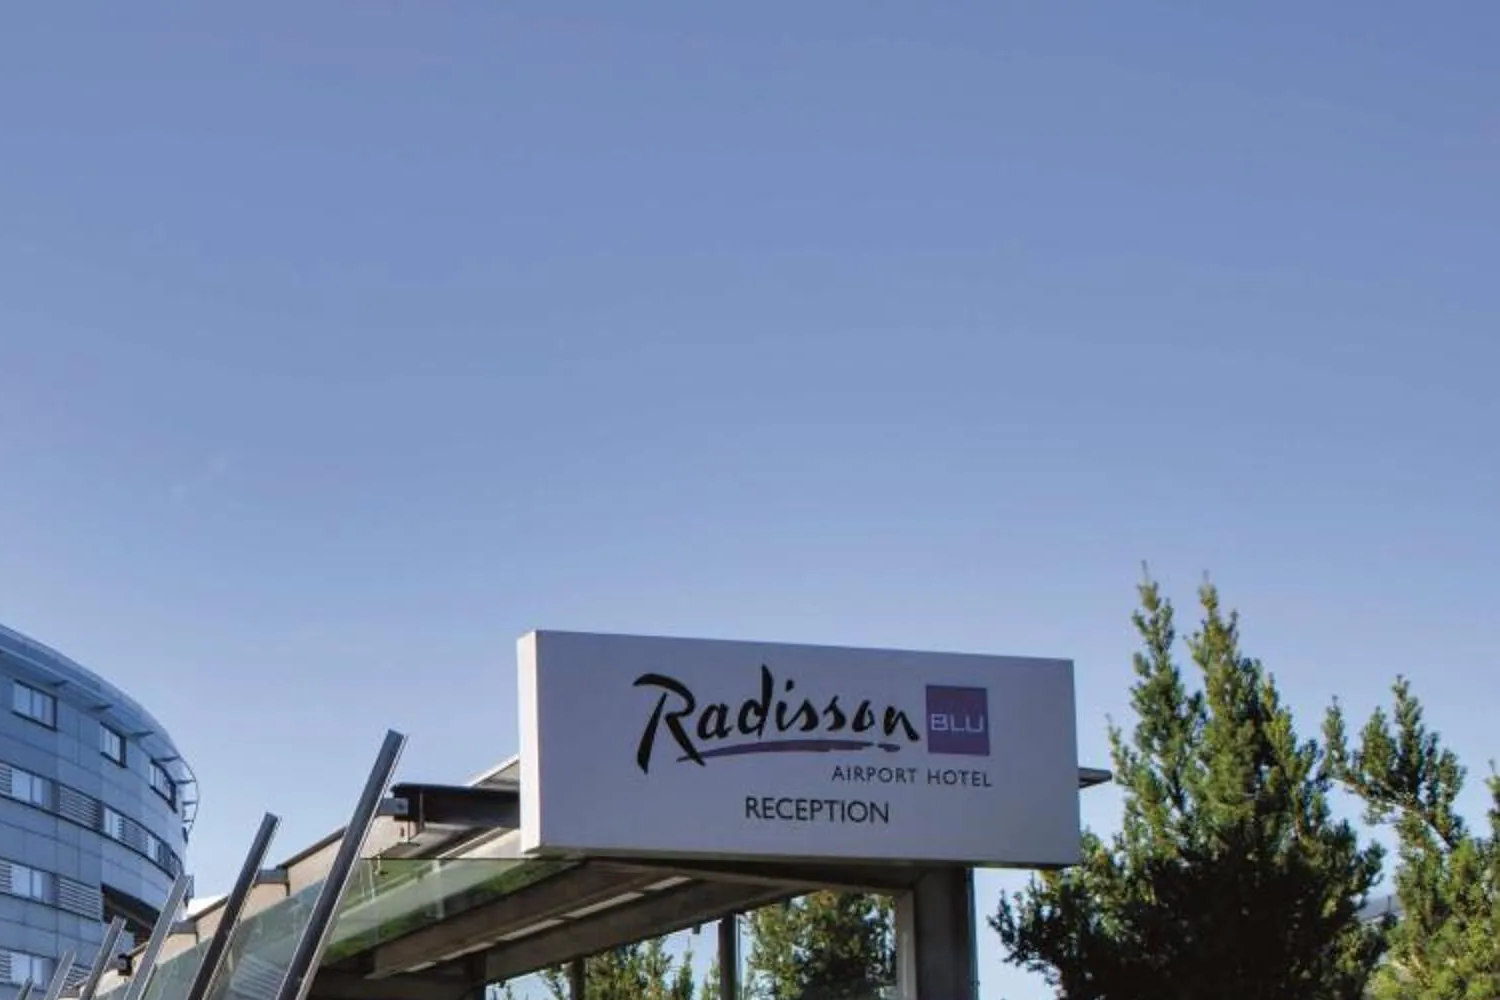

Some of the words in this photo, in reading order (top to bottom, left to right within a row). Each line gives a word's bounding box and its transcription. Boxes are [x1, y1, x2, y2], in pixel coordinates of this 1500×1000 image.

[633, 665, 920, 773] Radisson
[930, 712, 984, 733] BLU
[831, 764, 917, 785] AIRPORT
[927, 768, 993, 788] HOTEL
[745, 796, 890, 824] RECEPTION
